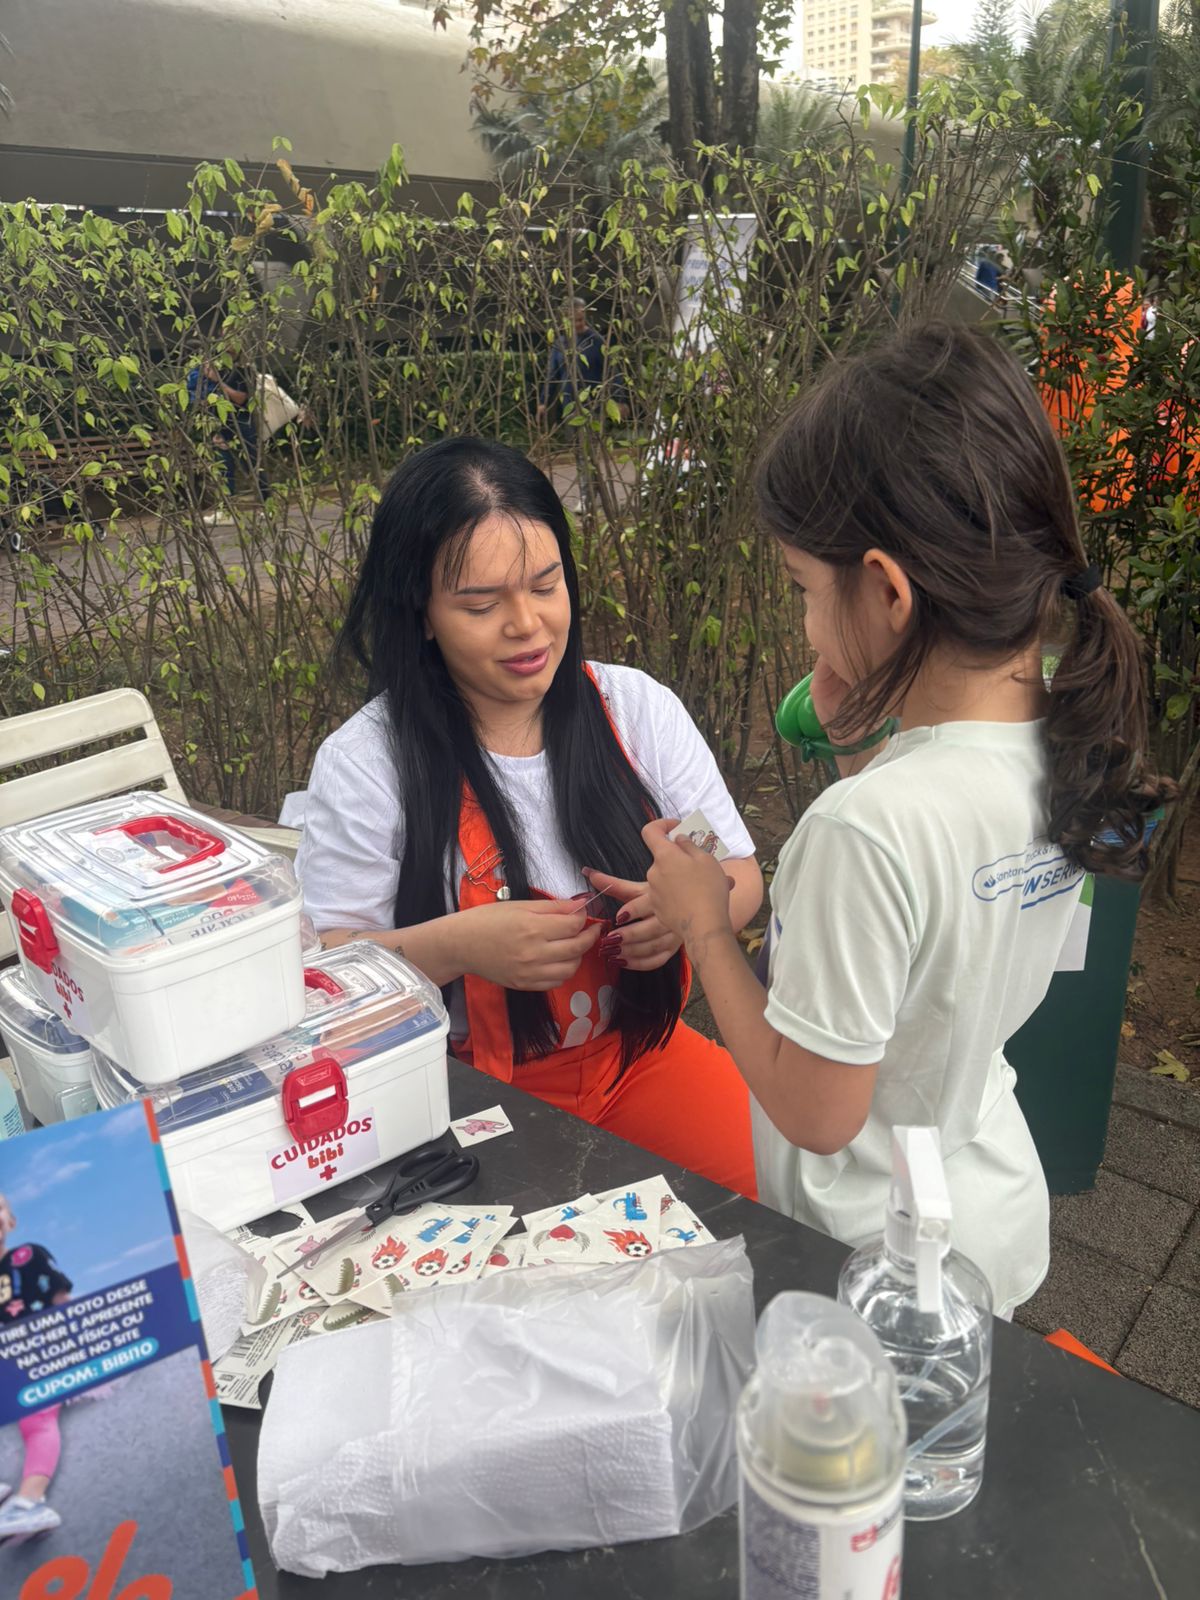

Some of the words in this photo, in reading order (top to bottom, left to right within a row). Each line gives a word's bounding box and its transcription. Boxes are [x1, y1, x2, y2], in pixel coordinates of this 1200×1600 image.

[52, 962, 84, 1001] DADOS
[271, 1117, 372, 1169] CUIDADOS
[307, 1143, 344, 1168] bibi
[0, 1325, 27, 1344] TIRE
[29, 1311, 66, 1332] UMA
[66, 1297, 104, 1318] FOTO
[106, 1279, 147, 1304] DESSE
[0, 1326, 68, 1359] VOUCHER
[69, 1321, 79, 1332] E
[81, 1293, 153, 1329] APRESENTE
[16, 1353, 40, 1370] NA
[42, 1338, 76, 1360] LOJA
[77, 1322, 120, 1346] FÍSICA
[121, 1311, 144, 1328] OU
[28, 1350, 87, 1380] COMPRE
[88, 1340, 112, 1356] NO
[113, 1328, 140, 1347] SITE
[23, 1366, 98, 1403] CUPOM:
